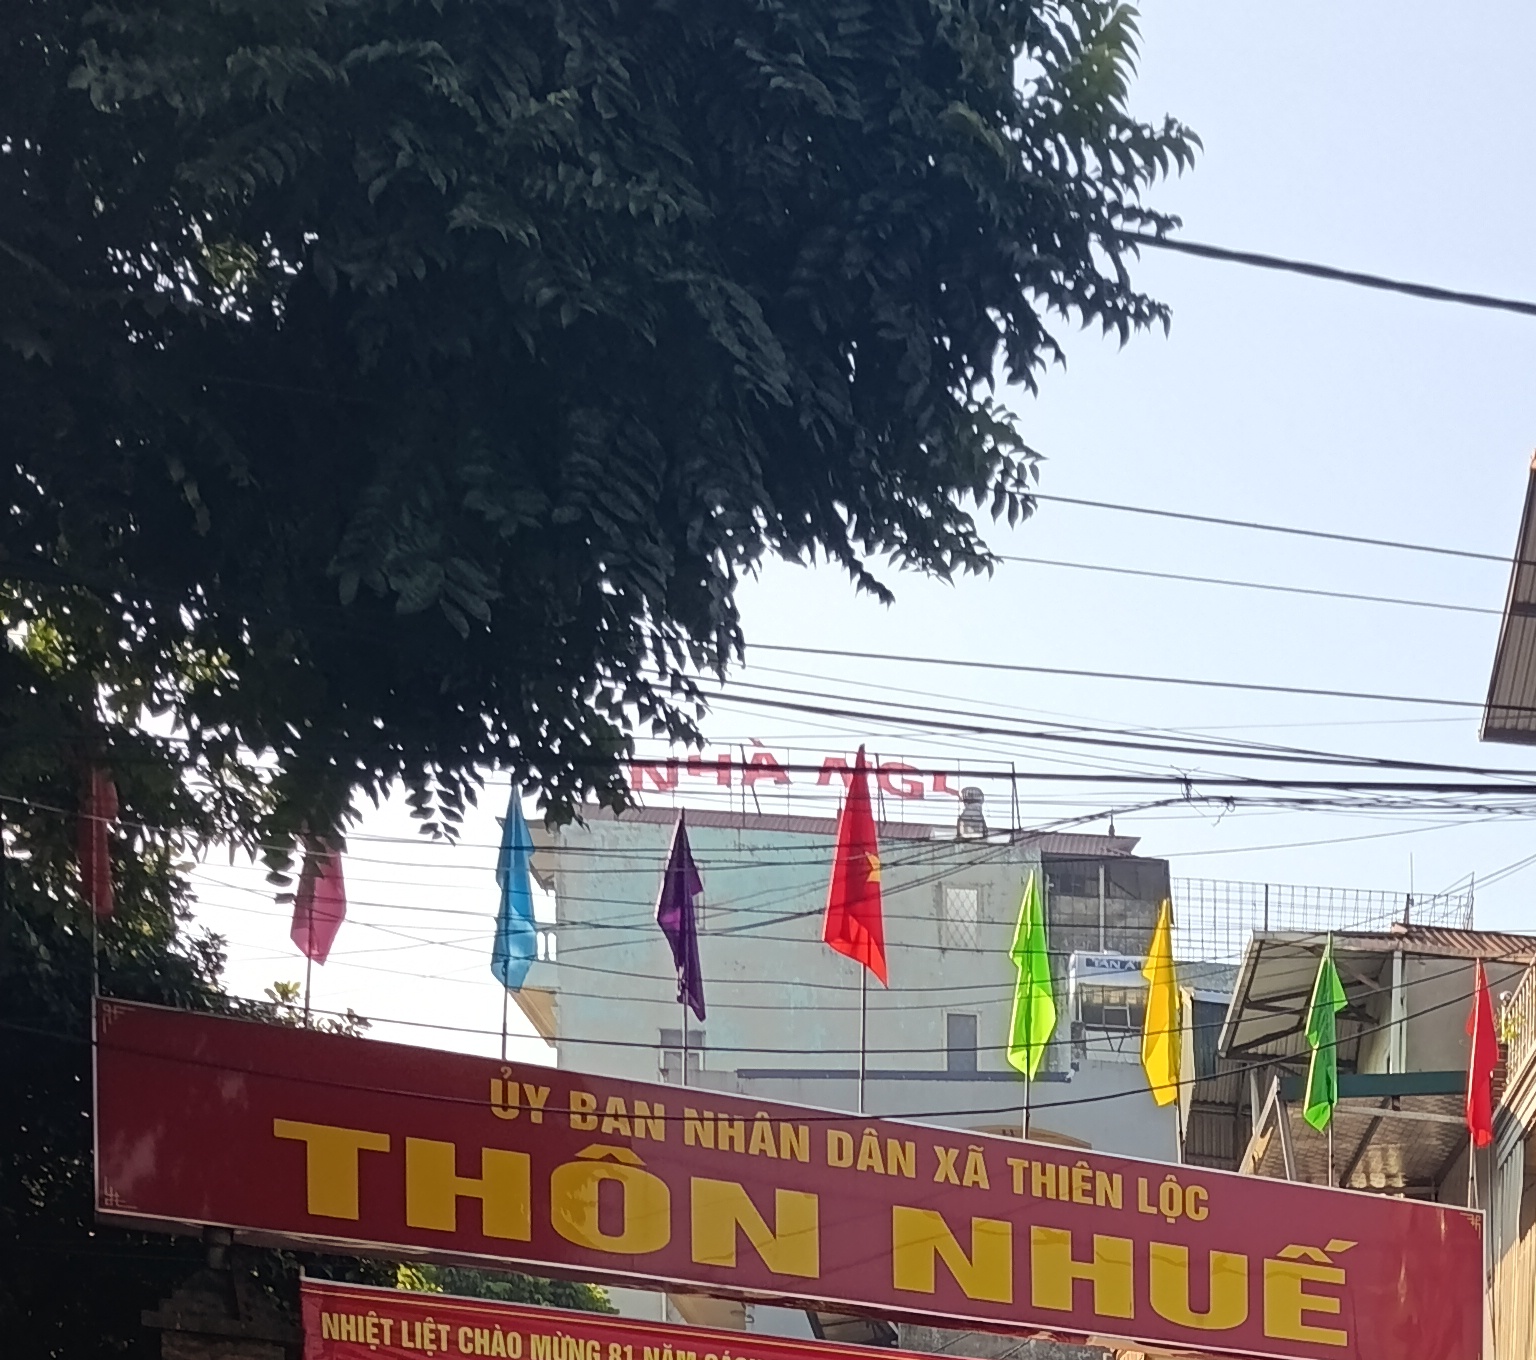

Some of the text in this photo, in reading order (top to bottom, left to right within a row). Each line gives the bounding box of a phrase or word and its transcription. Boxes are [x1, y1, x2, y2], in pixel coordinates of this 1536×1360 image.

[490, 1066, 1209, 1225] ỦY BAN NHÂN DÂN XÃ THIÊN LỘC
[274, 1118, 1358, 1347] THÔN NHUẾ
[322, 1312, 394, 1351] NHIỆT
[401, 1317, 450, 1357] LIỆT
[458, 1322, 522, 1360] CHÀO
